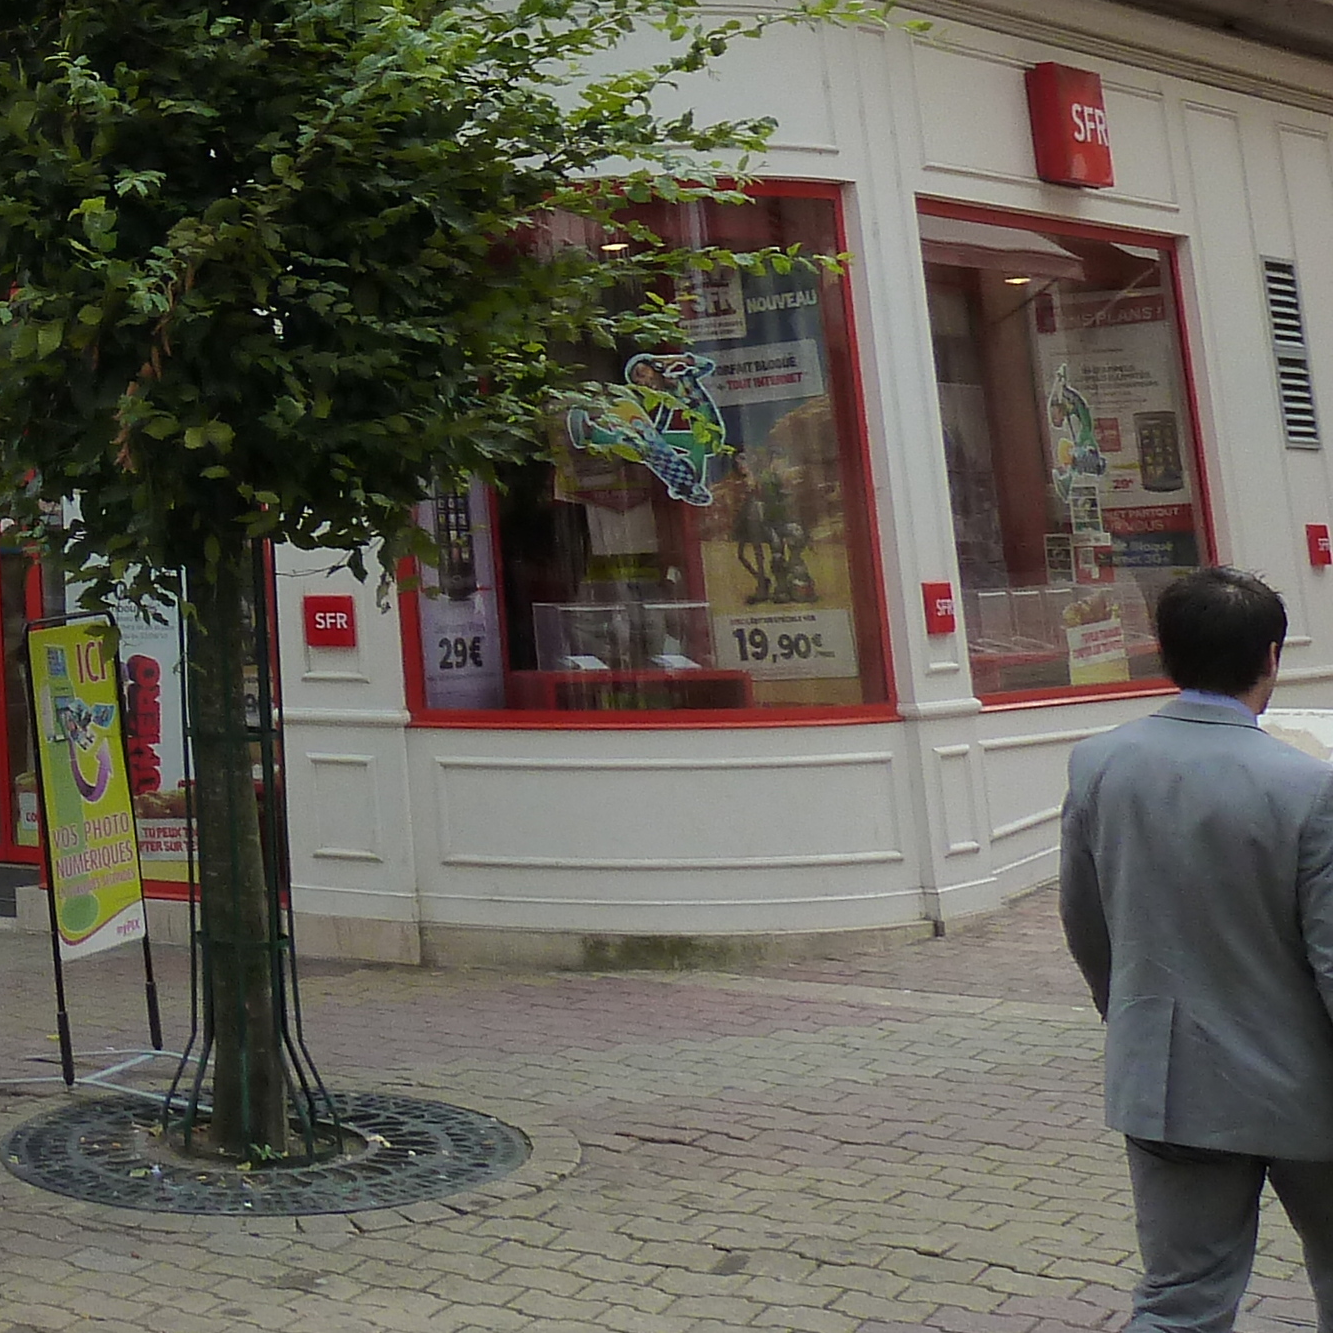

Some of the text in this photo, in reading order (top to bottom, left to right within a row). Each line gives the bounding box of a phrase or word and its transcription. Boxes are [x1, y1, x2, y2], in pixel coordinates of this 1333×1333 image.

[1072, 103, 1110, 146] SFR
[746, 288, 817, 314] NOUVEAU
[315, 612, 348, 629] SFR
[77, 640, 106, 683] ICI
[438, 636, 483, 669] 29€
[54, 812, 129, 848] VOS PHOTO
[57, 840, 133, 878] NUMÉRIQUES
